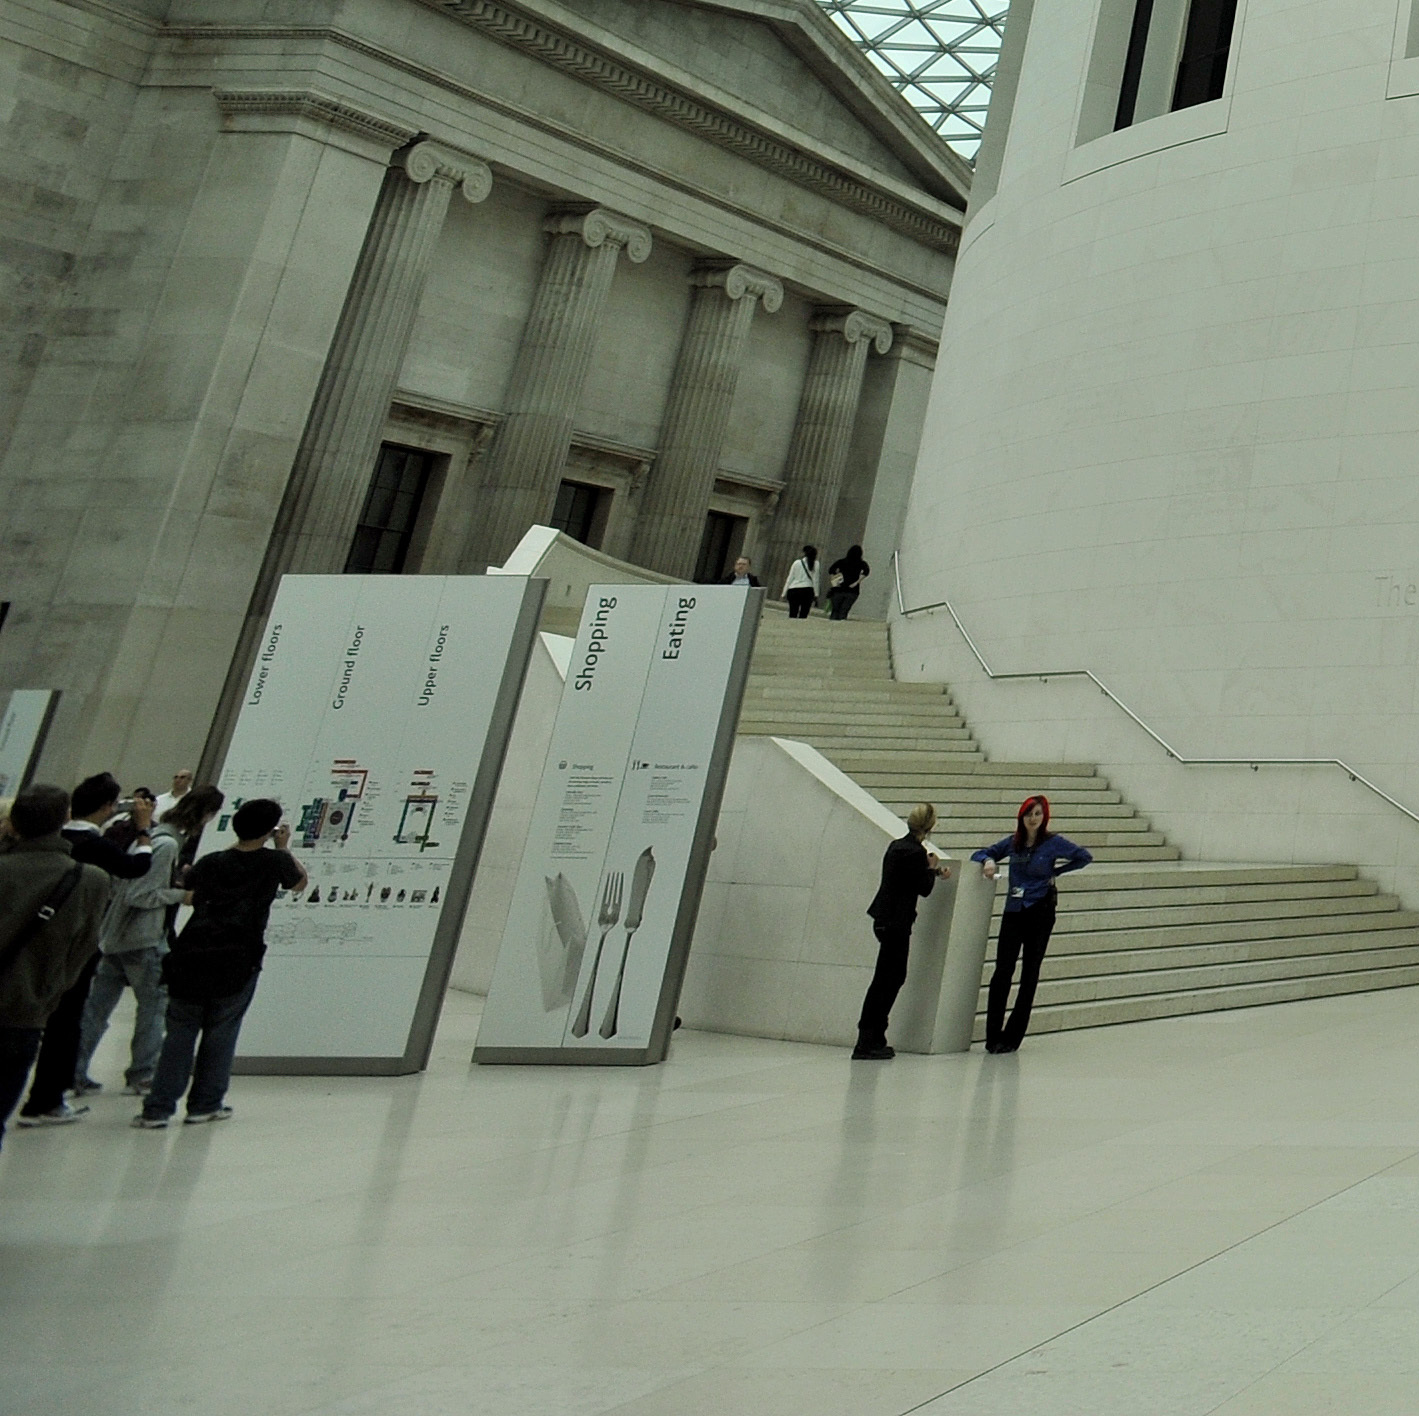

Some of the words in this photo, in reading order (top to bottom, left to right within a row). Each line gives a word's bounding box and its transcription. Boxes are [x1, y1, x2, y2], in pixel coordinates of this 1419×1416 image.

[248, 664, 270, 706] Lower
[262, 624, 283, 662] floors
[332, 661, 355, 710] Ground
[346, 625, 366, 657] floor
[417, 666, 438, 707] Upper
[429, 624, 450, 662] floors
[575, 596, 618, 691] Shopping
[662, 596, 697, 660] Eating
